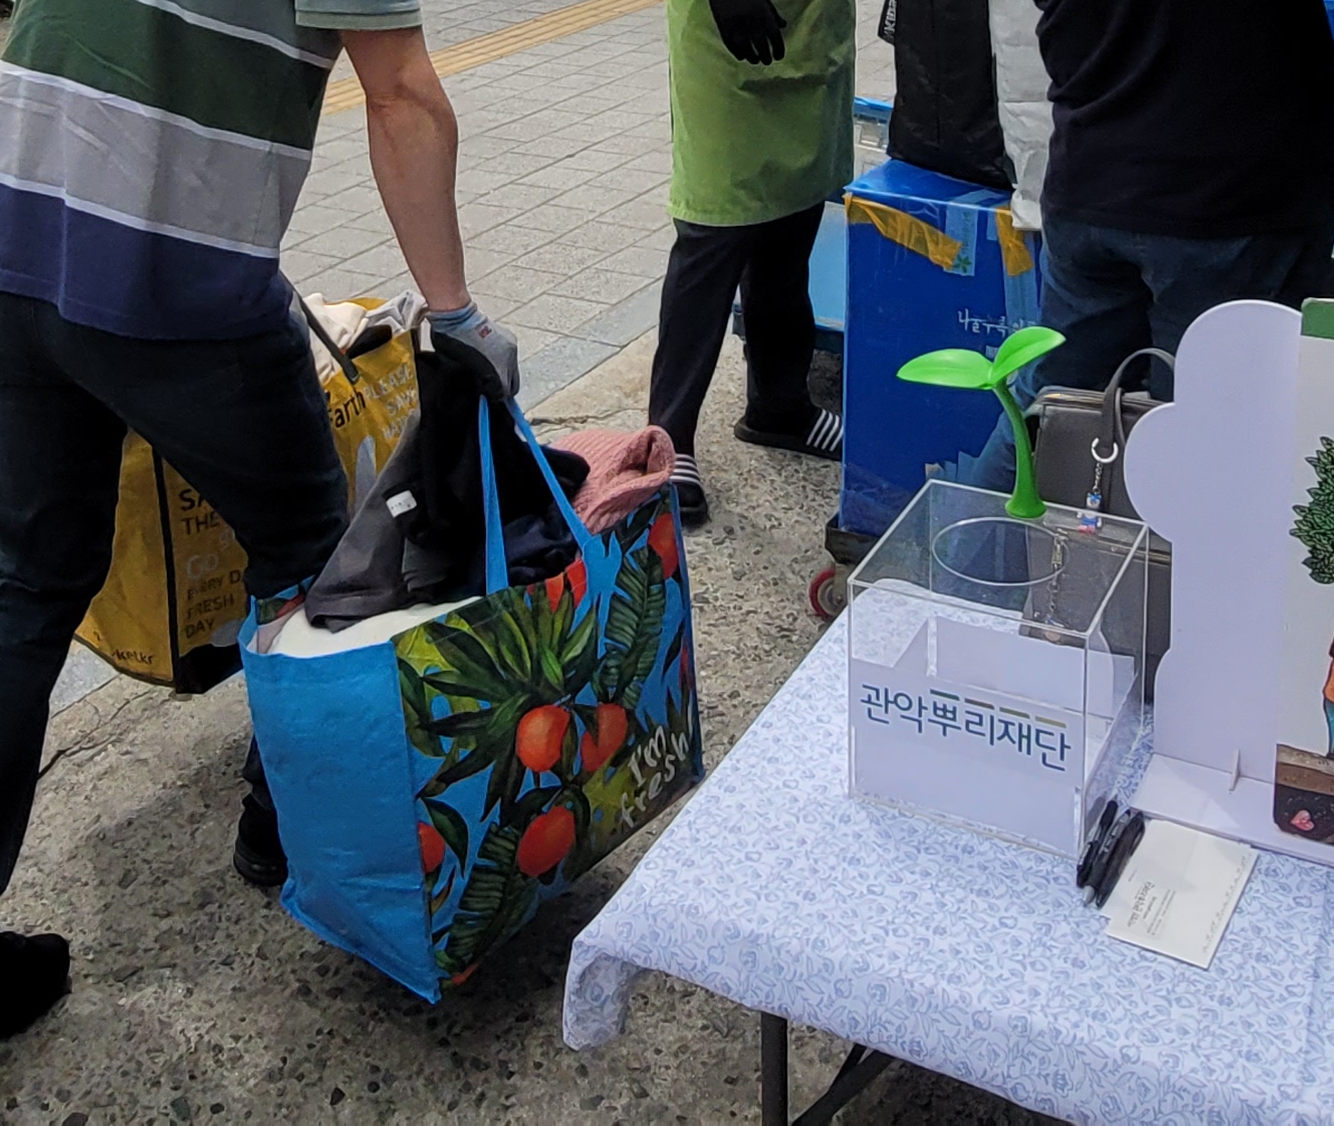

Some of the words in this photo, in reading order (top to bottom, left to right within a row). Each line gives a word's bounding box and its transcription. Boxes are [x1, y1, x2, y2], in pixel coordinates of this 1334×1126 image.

[187, 593, 235, 620] FRESH
[184, 619, 215, 639] DAY
[860, 683, 1072, 772] 관악뿌리재단
